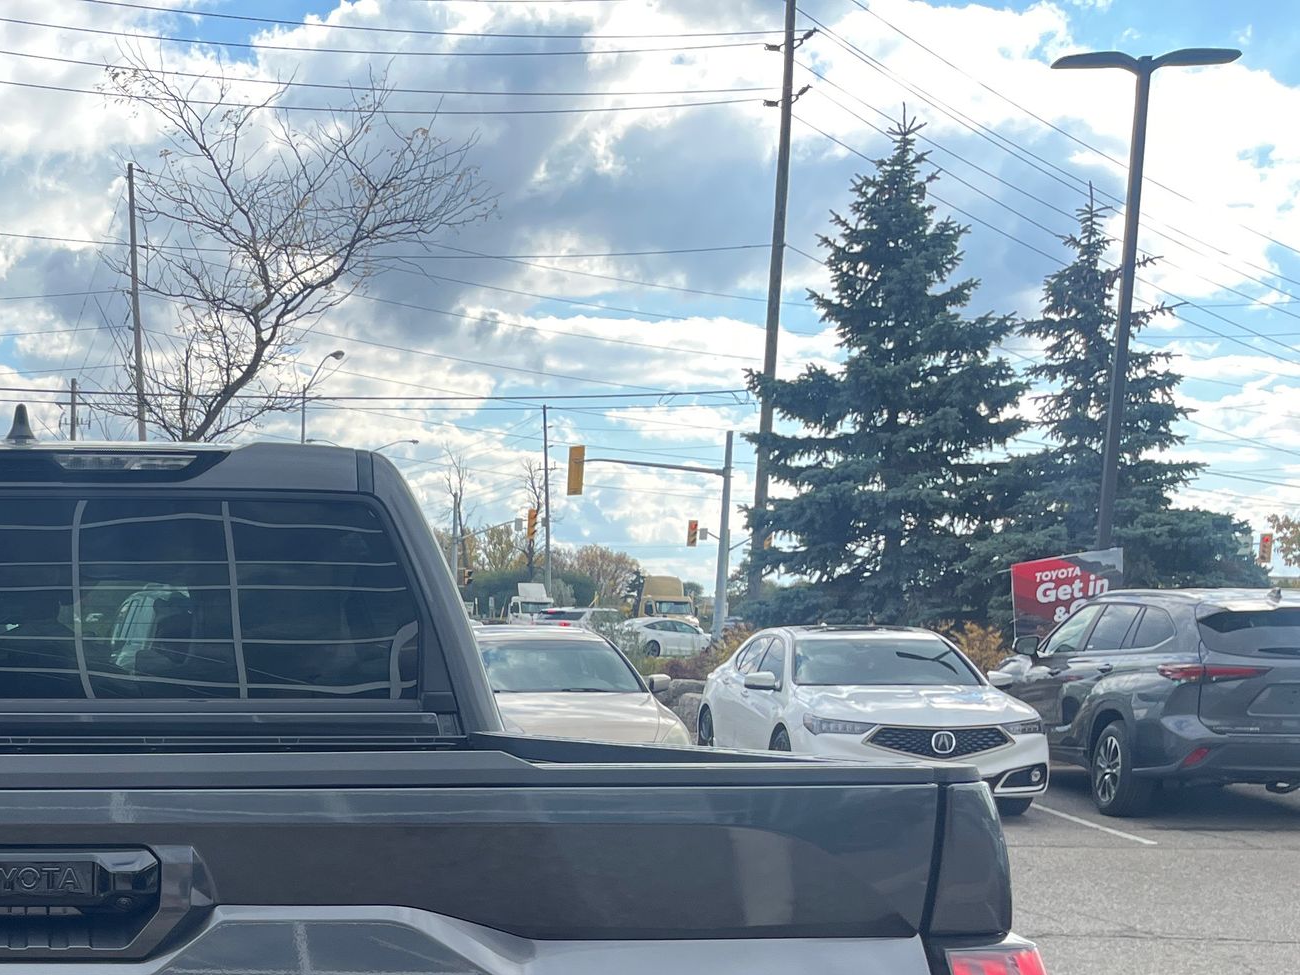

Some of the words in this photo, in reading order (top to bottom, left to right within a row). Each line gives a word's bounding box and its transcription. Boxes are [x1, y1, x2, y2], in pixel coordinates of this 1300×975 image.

[1035, 566, 1081, 582] TOYOTA
[1036, 579, 1083, 604] Get
[1088, 574, 1109, 596] in
